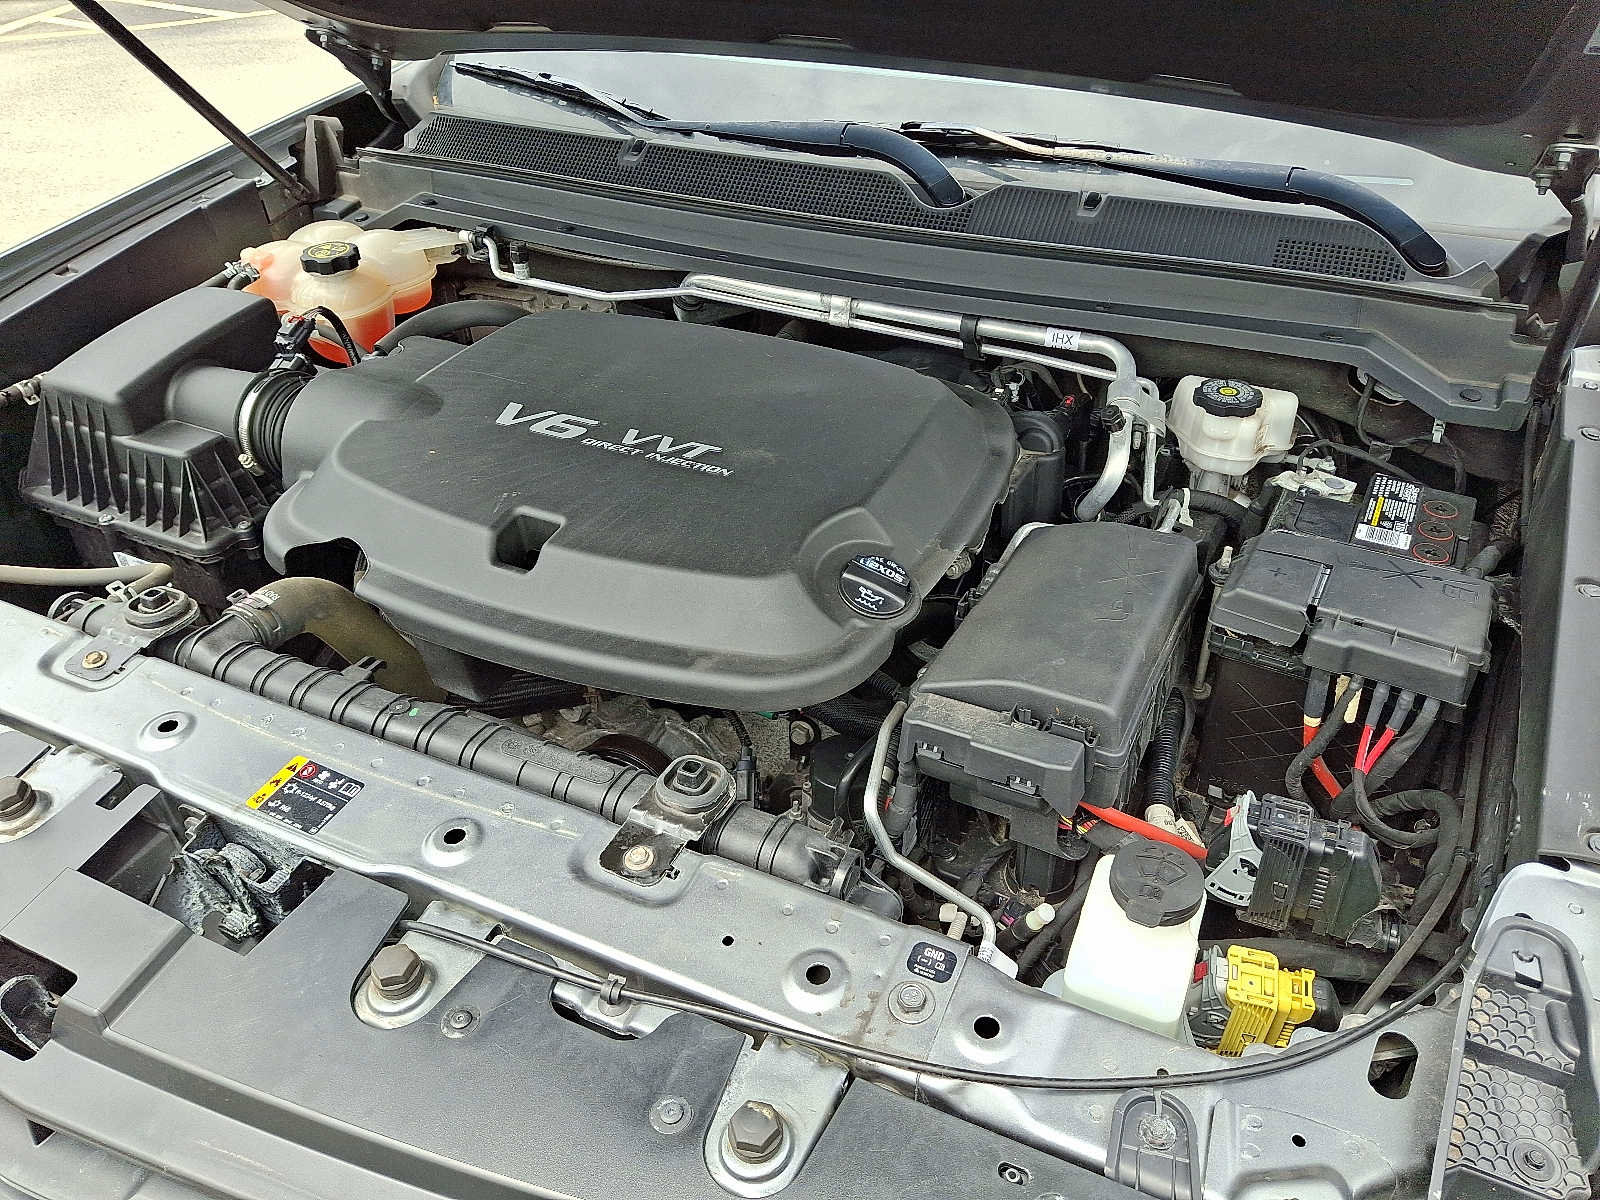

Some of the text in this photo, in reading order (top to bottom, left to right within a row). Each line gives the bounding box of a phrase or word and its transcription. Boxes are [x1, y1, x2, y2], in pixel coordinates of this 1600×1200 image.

[496, 401, 601, 439] V6
[580, 437, 644, 456] DIRECT
[621, 428, 723, 459] VVT
[644, 452, 735, 477] INJECTION
[924, 947, 946, 962] GND
